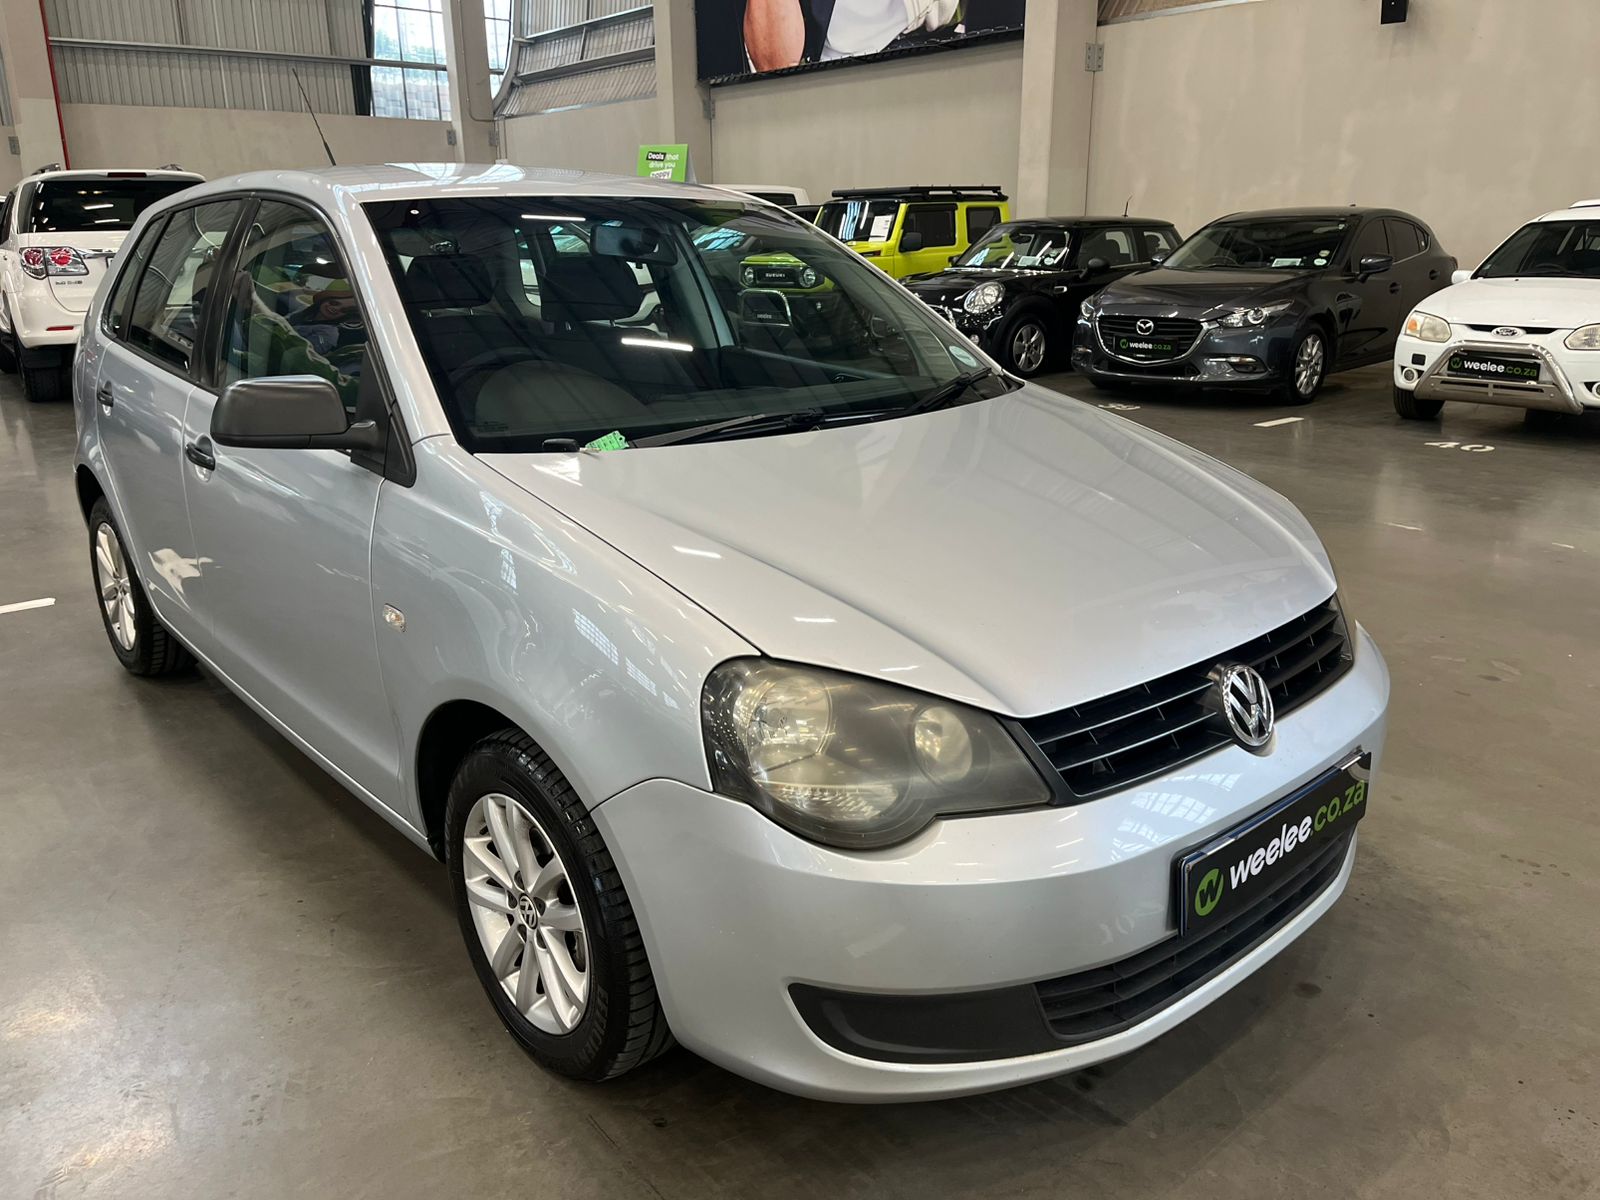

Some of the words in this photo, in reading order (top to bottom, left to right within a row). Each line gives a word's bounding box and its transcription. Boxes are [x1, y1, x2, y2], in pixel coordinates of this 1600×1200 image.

[648, 152, 665, 160] Deals
[664, 161, 676, 169] you
[1129, 341, 1171, 350] weelee.co.za
[1464, 359, 1537, 377] weelee.co.za
[1424, 441, 1495, 452] 40
[1229, 779, 1365, 890] weelee.co.za
